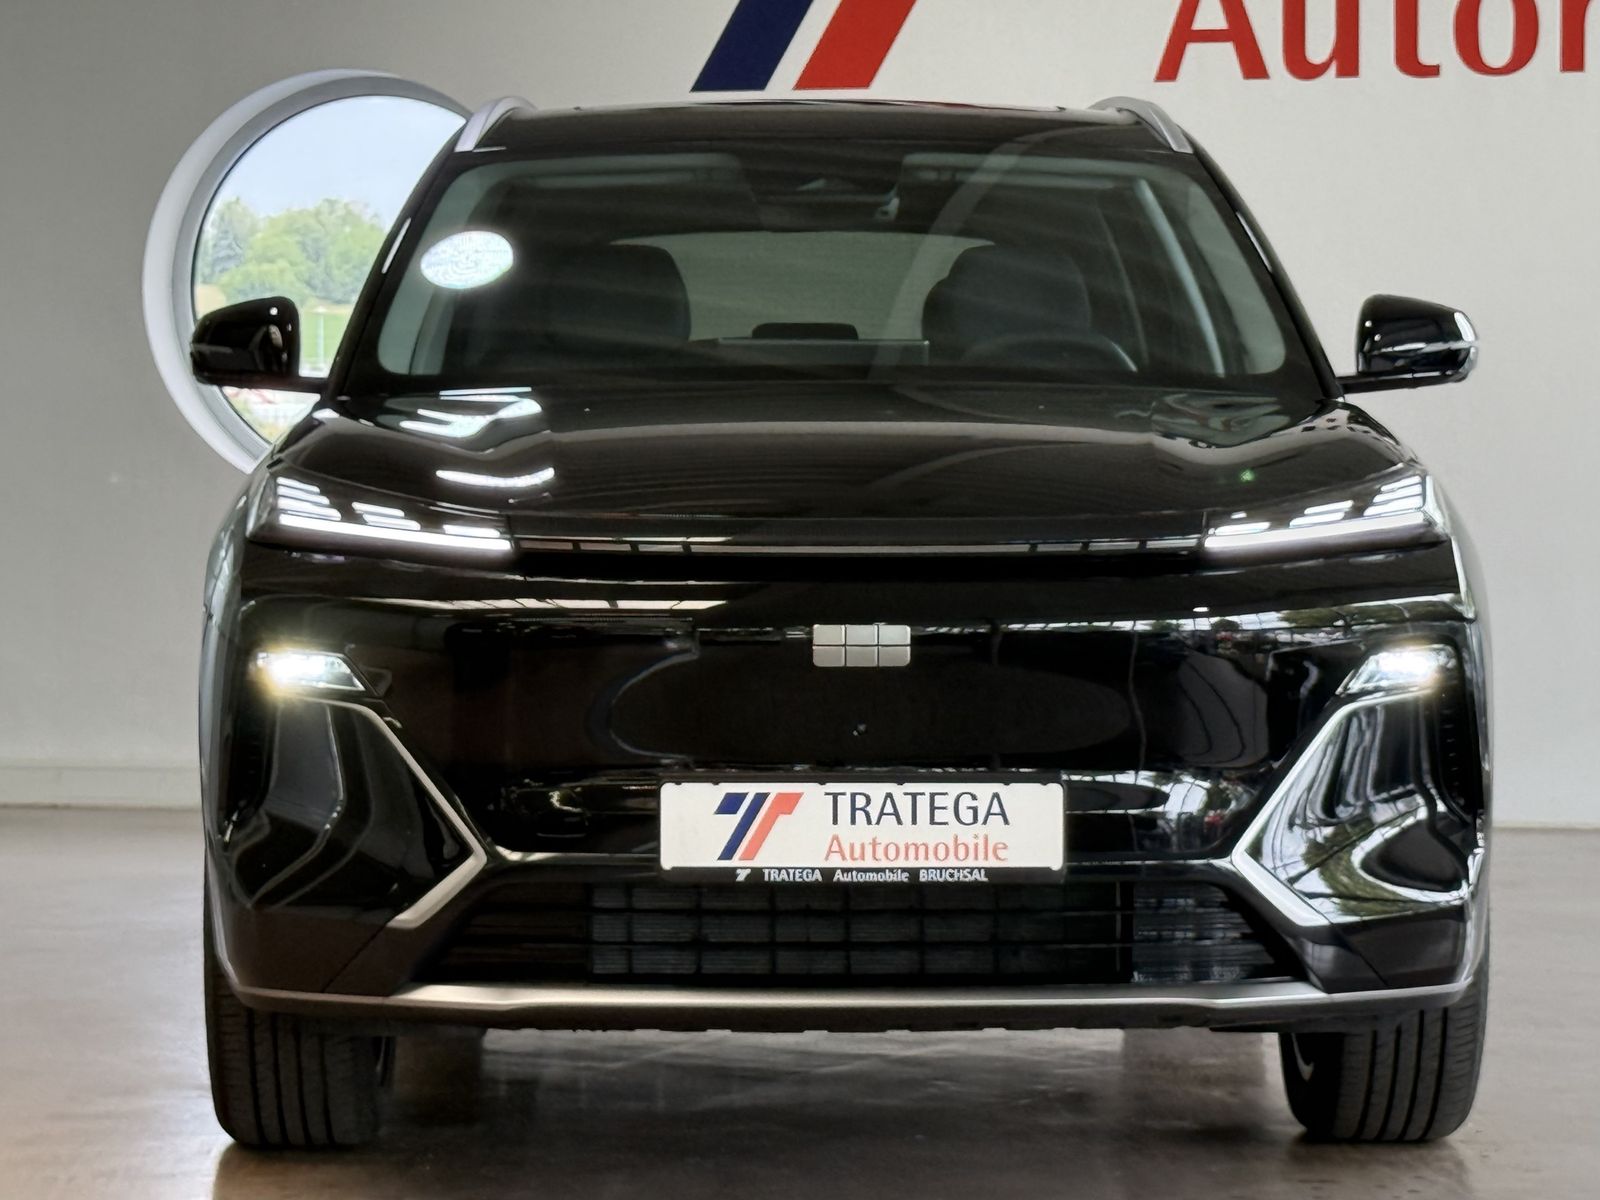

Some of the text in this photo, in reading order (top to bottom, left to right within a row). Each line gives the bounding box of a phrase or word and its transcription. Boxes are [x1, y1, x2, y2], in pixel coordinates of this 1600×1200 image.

[823, 791, 1010, 826] TRATEGA
[823, 833, 1009, 862] Automobile
[762, 868, 989, 882] TRATEGA Automobile BRUCHSAL
